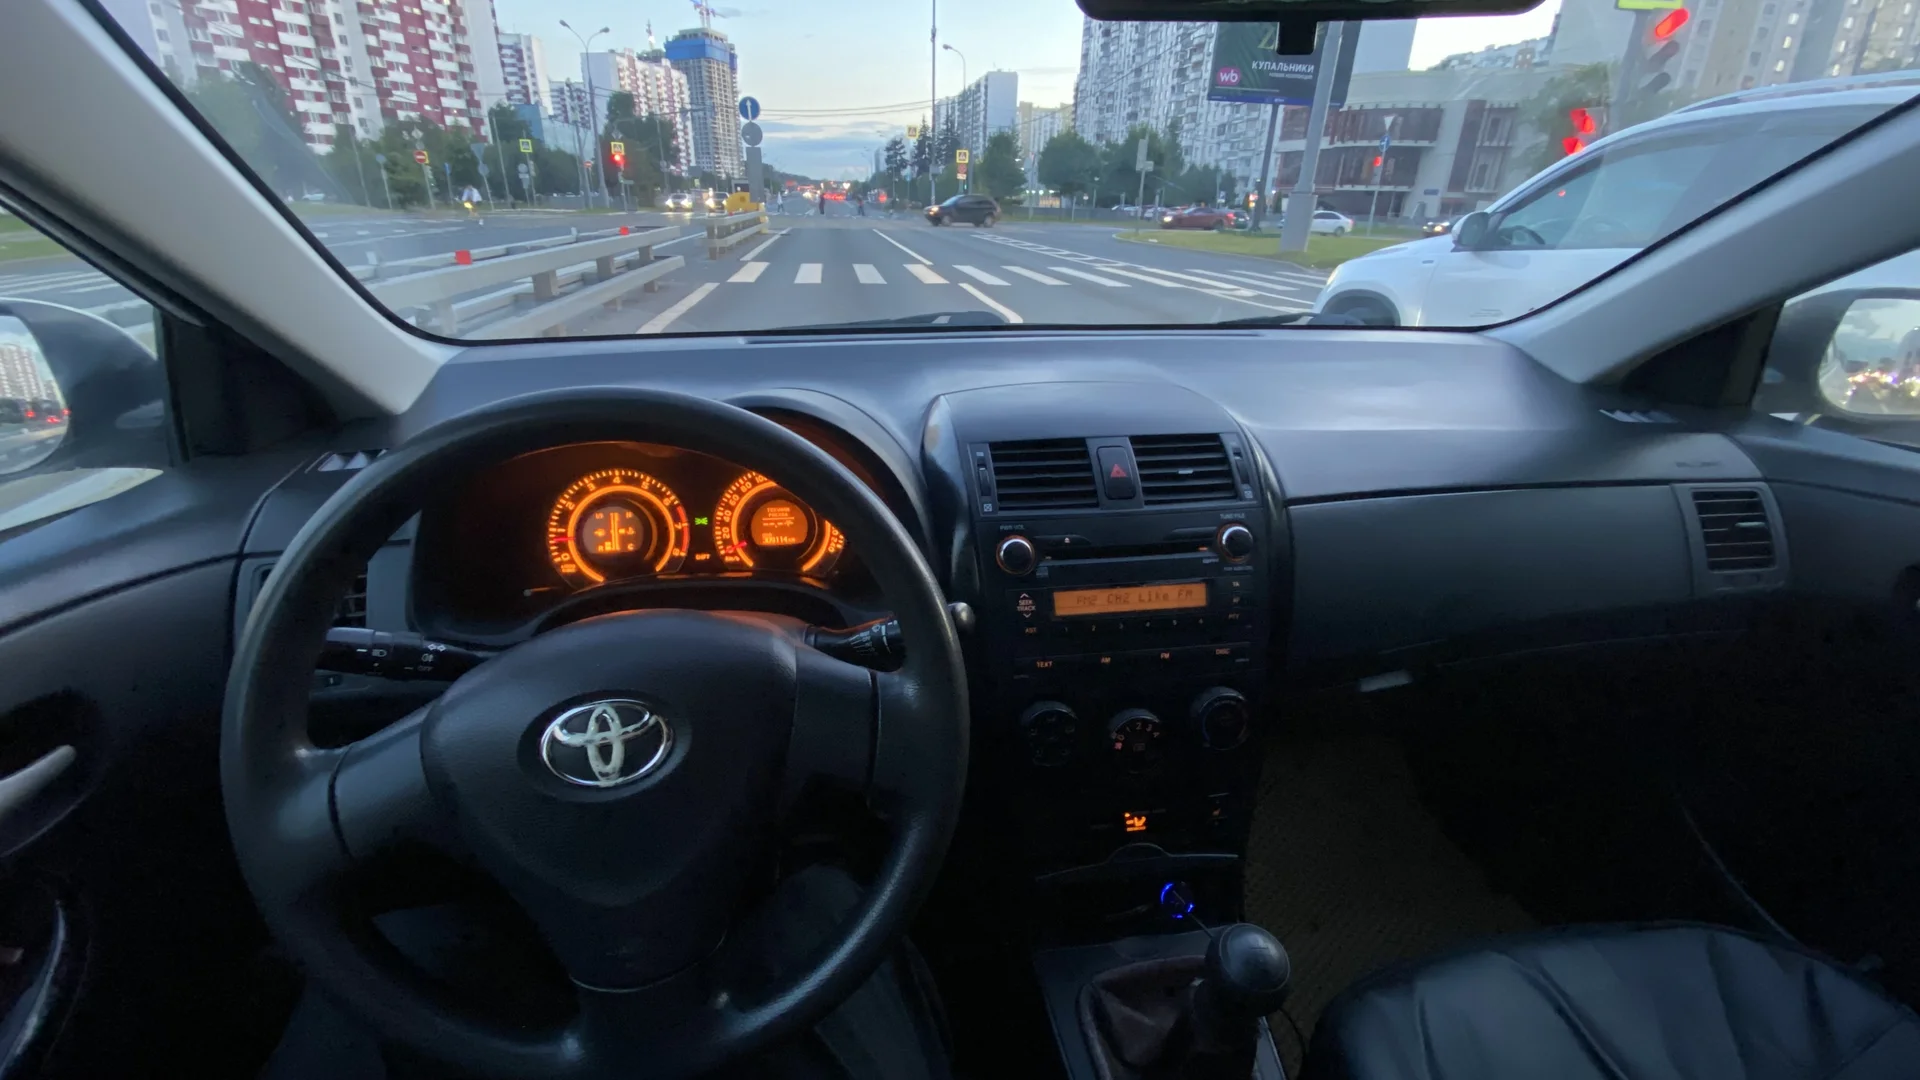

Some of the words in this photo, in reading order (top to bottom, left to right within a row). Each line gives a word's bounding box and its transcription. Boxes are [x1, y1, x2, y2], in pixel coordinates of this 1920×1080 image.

[1252, 60, 1315, 73] КУПАЛЬНИКИ
[1219, 69, 1238, 83] wb
[613, 476, 620, 484] 4
[641, 481, 650, 490] 5
[586, 483, 596, 491] 3
[740, 481, 752, 493] 80
[566, 501, 575, 510] 2
[729, 494, 740, 506] 60
[723, 510, 732, 522] 40
[722, 527, 730, 539] 20
[561, 553, 570, 561] 0
[1138, 590, 1169, 603] Like
[1177, 588, 1193, 600] FM
[1036, 660, 1053, 668] TEXT
